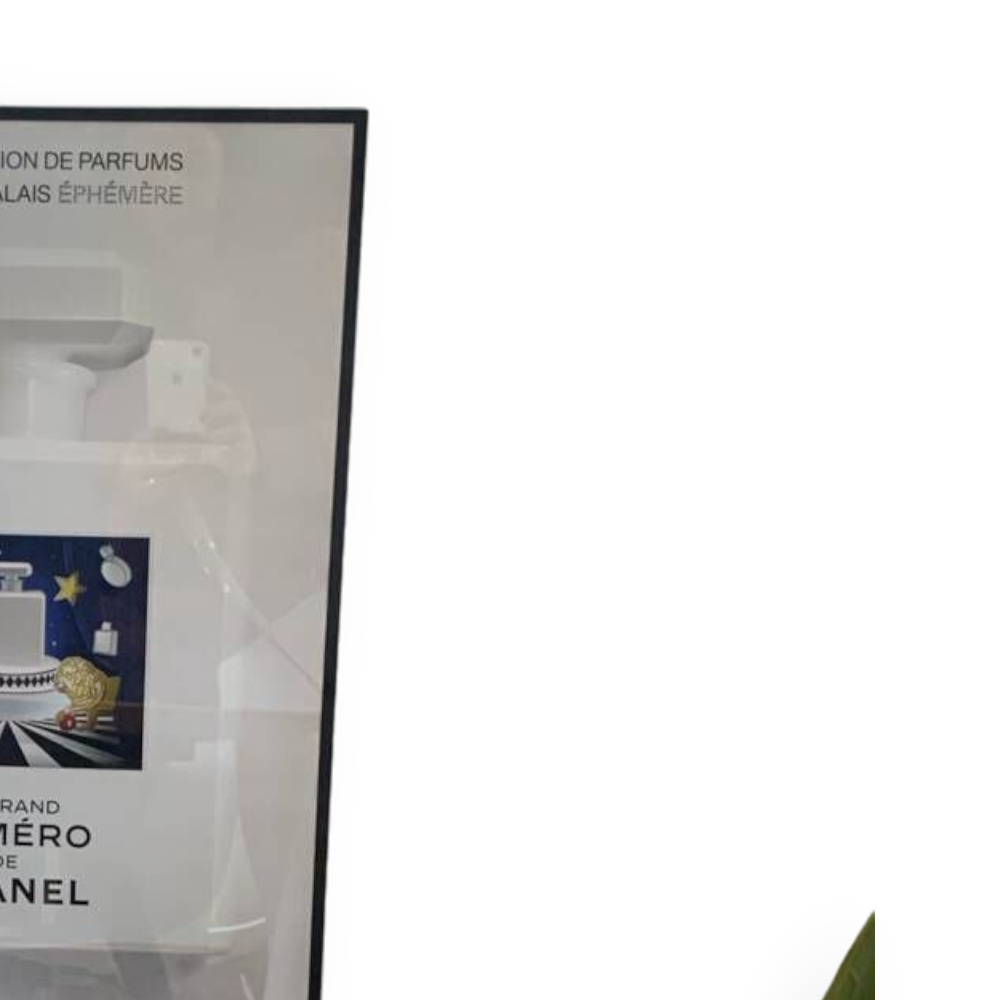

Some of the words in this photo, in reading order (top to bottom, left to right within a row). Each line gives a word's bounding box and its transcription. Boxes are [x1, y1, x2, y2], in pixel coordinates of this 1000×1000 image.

[44, 152, 73, 170] DE
[78, 152, 184, 171] PARFUMS
[58, 180, 184, 205] ÉPHÉMÈRE
